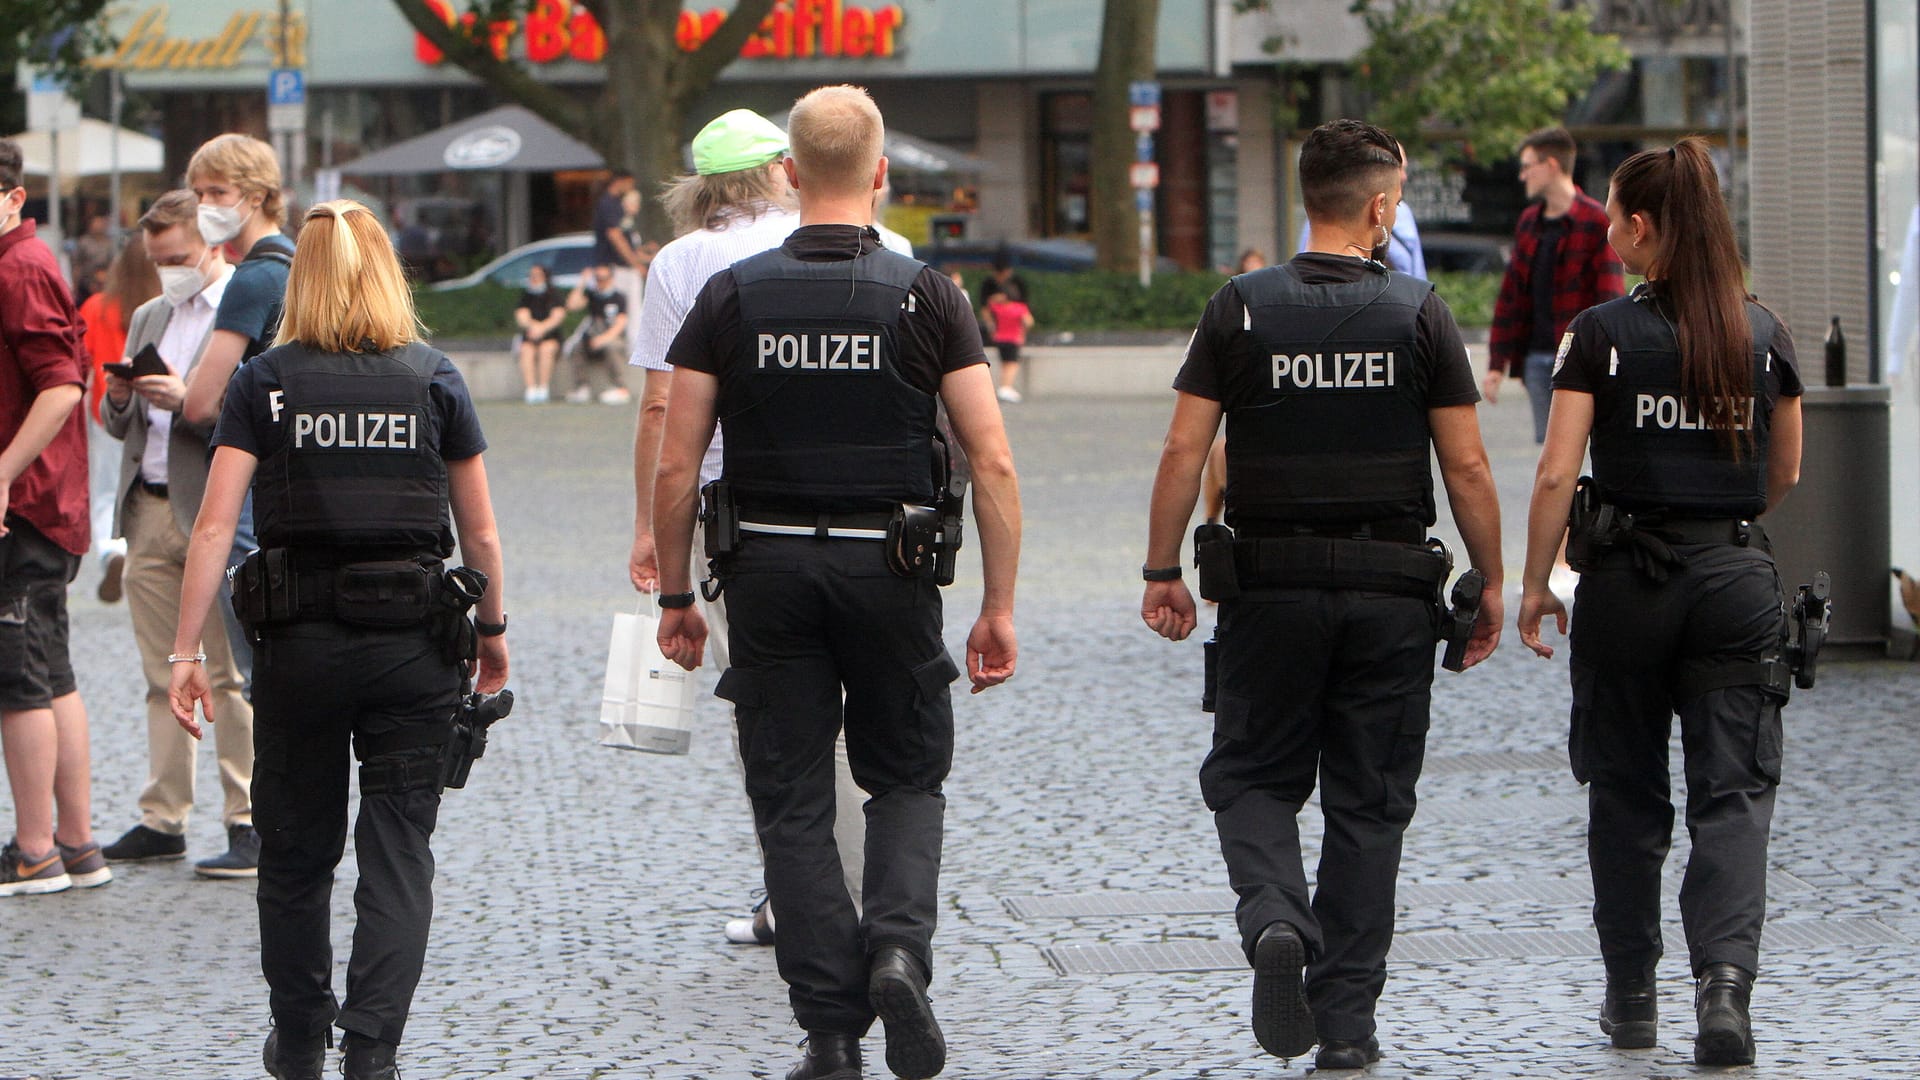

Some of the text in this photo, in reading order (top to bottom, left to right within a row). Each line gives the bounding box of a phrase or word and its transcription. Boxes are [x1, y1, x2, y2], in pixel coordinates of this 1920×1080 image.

[758, 334, 880, 369] POLIZEI
[1272, 352, 1394, 388] POLIZEI
[295, 413, 416, 448] POLIZEI
